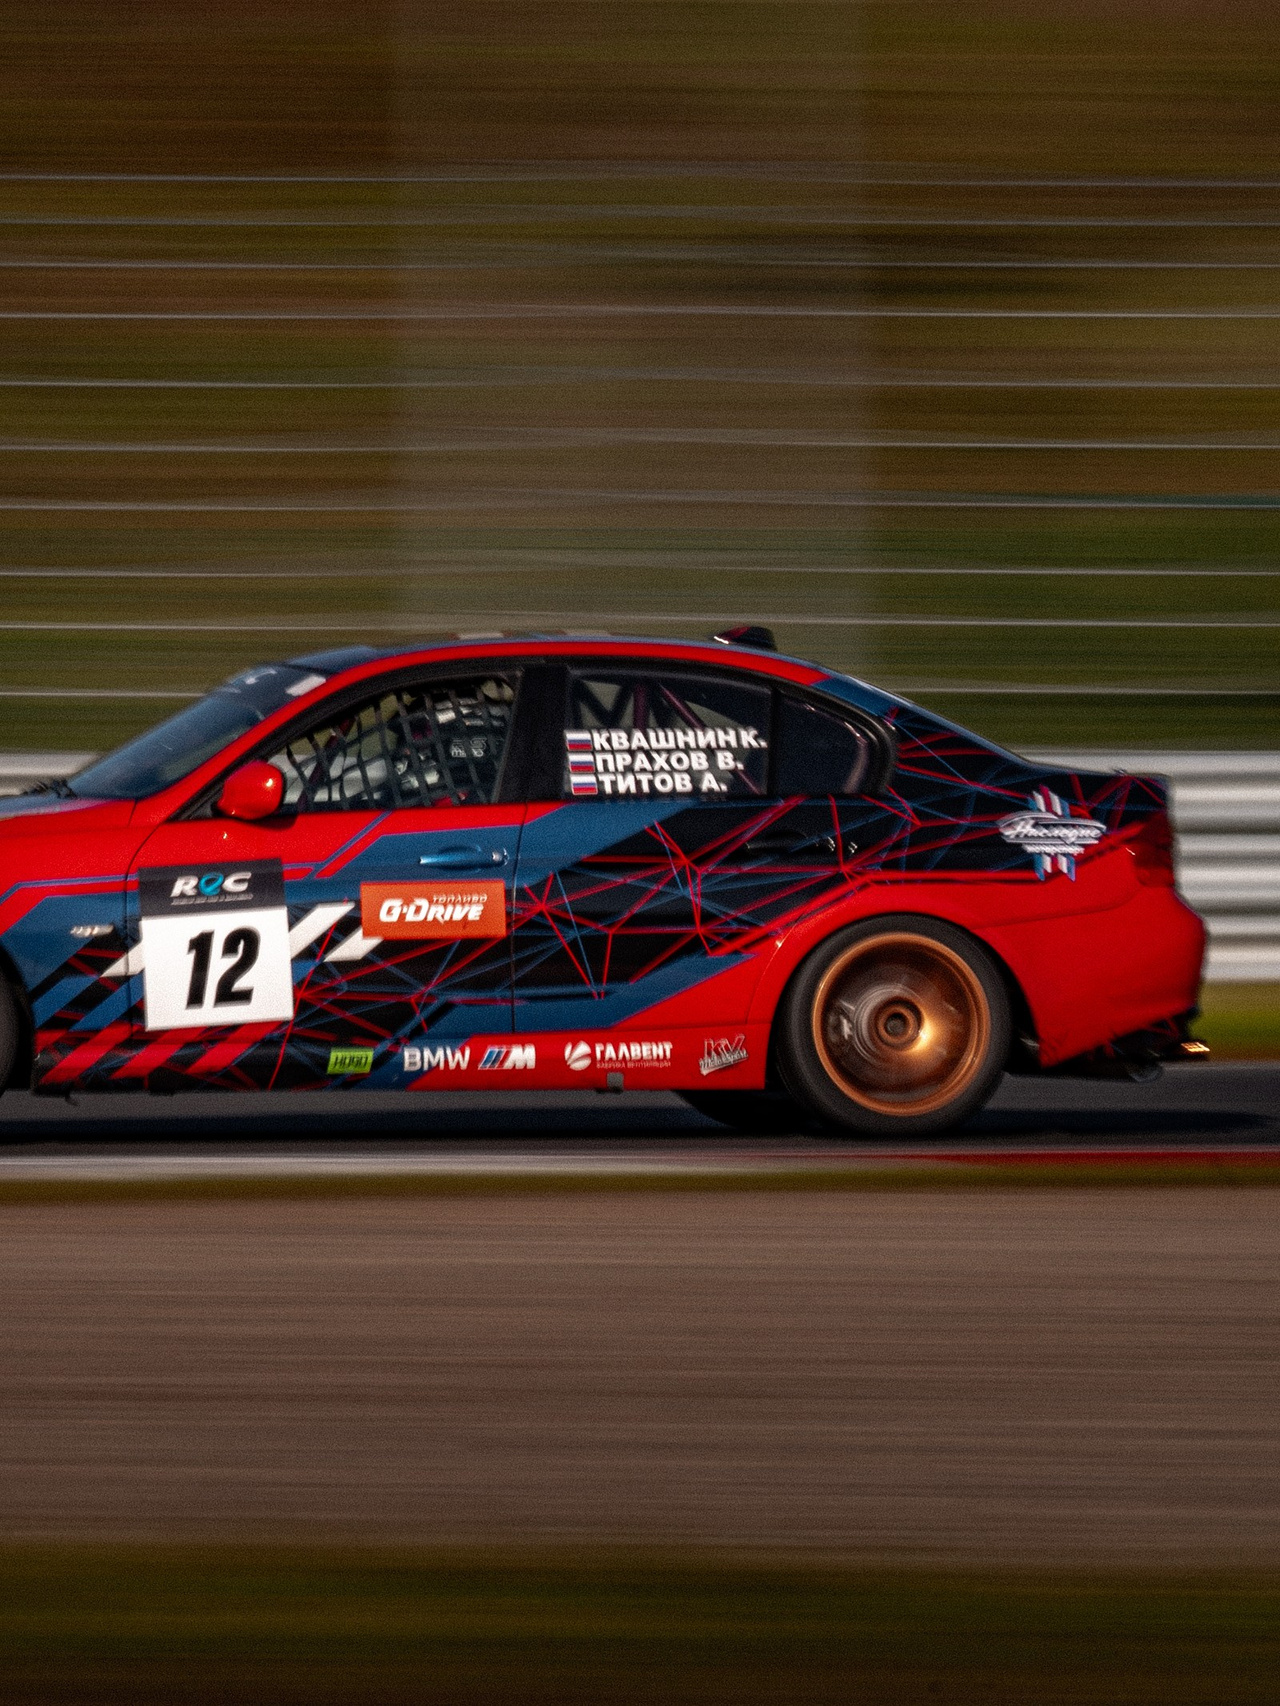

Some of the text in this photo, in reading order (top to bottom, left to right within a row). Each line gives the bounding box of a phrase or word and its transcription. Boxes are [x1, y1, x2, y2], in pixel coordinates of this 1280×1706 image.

[592, 726, 768, 750] КВАШНИН К.
[595, 749, 744, 772] ПРАХОВ В.
[598, 771, 728, 794] ТИТОВ А.
[185, 925, 261, 1010] 12
[403, 1046, 470, 1071] BMW
[595, 1041, 673, 1061] ГАЛВЕНТ
